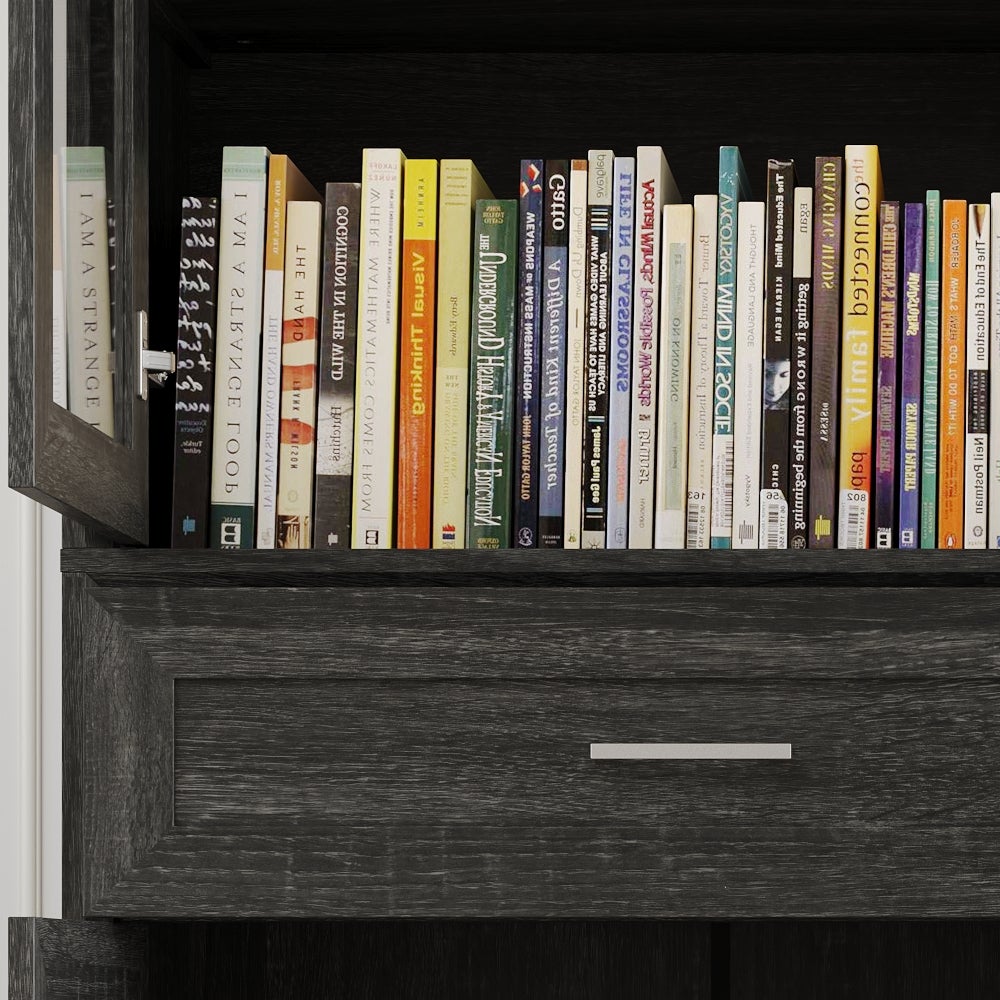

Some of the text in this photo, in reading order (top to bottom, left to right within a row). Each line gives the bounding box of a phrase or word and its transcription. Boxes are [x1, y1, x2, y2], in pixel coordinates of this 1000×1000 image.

[80, 212, 96, 247] AM
[81, 261, 96, 274] A
[83, 287, 100, 408] STRANGE
